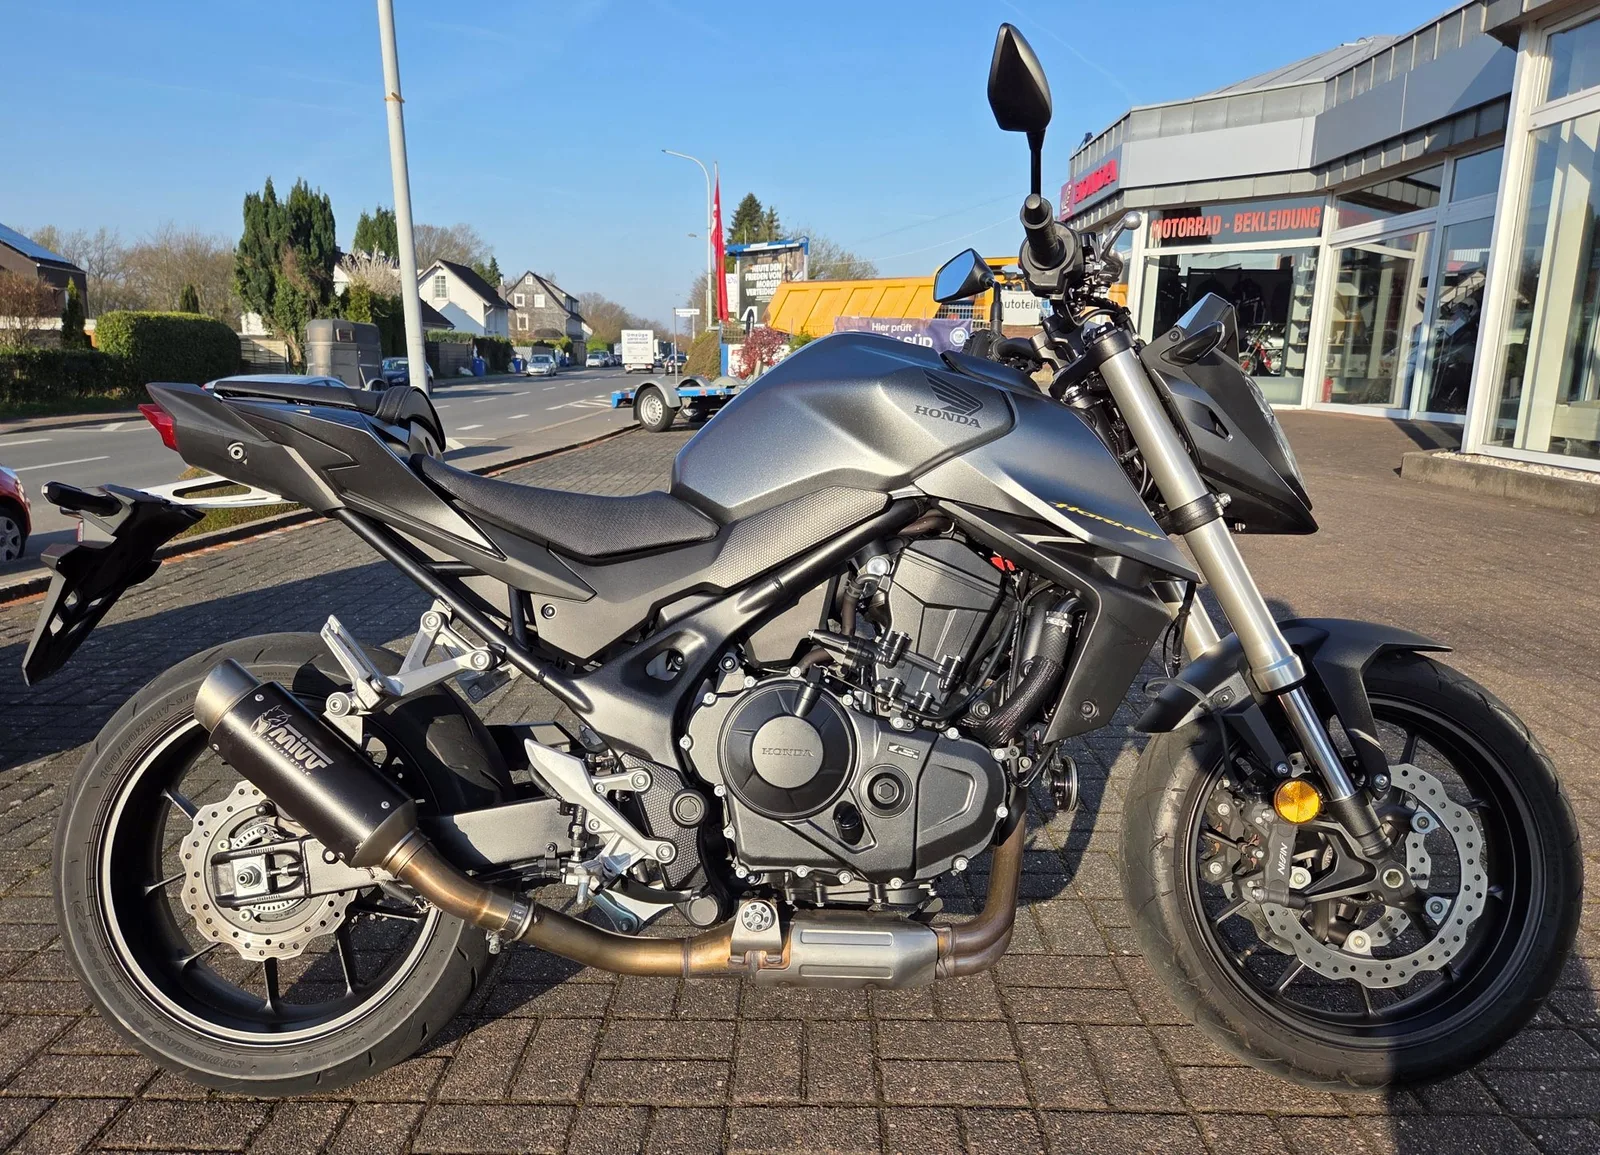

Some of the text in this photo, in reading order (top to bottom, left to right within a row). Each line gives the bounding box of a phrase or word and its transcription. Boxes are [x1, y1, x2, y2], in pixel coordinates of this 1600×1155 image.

[1151, 216, 1221, 239] MOTORRAD
[1234, 206, 1321, 233] BEKLEIDUNG
[770, 263, 782, 272] DEN
[745, 273, 768, 281] FRIEDEN
[769, 272, 782, 280] VON
[1003, 299, 1041, 309] utoteile
[872, 322, 912, 333] Hier prüft
[914, 405, 982, 428] HONDA
[263, 735, 312, 776] ITALIAN STYLE
[762, 748, 814, 757] HONDA
